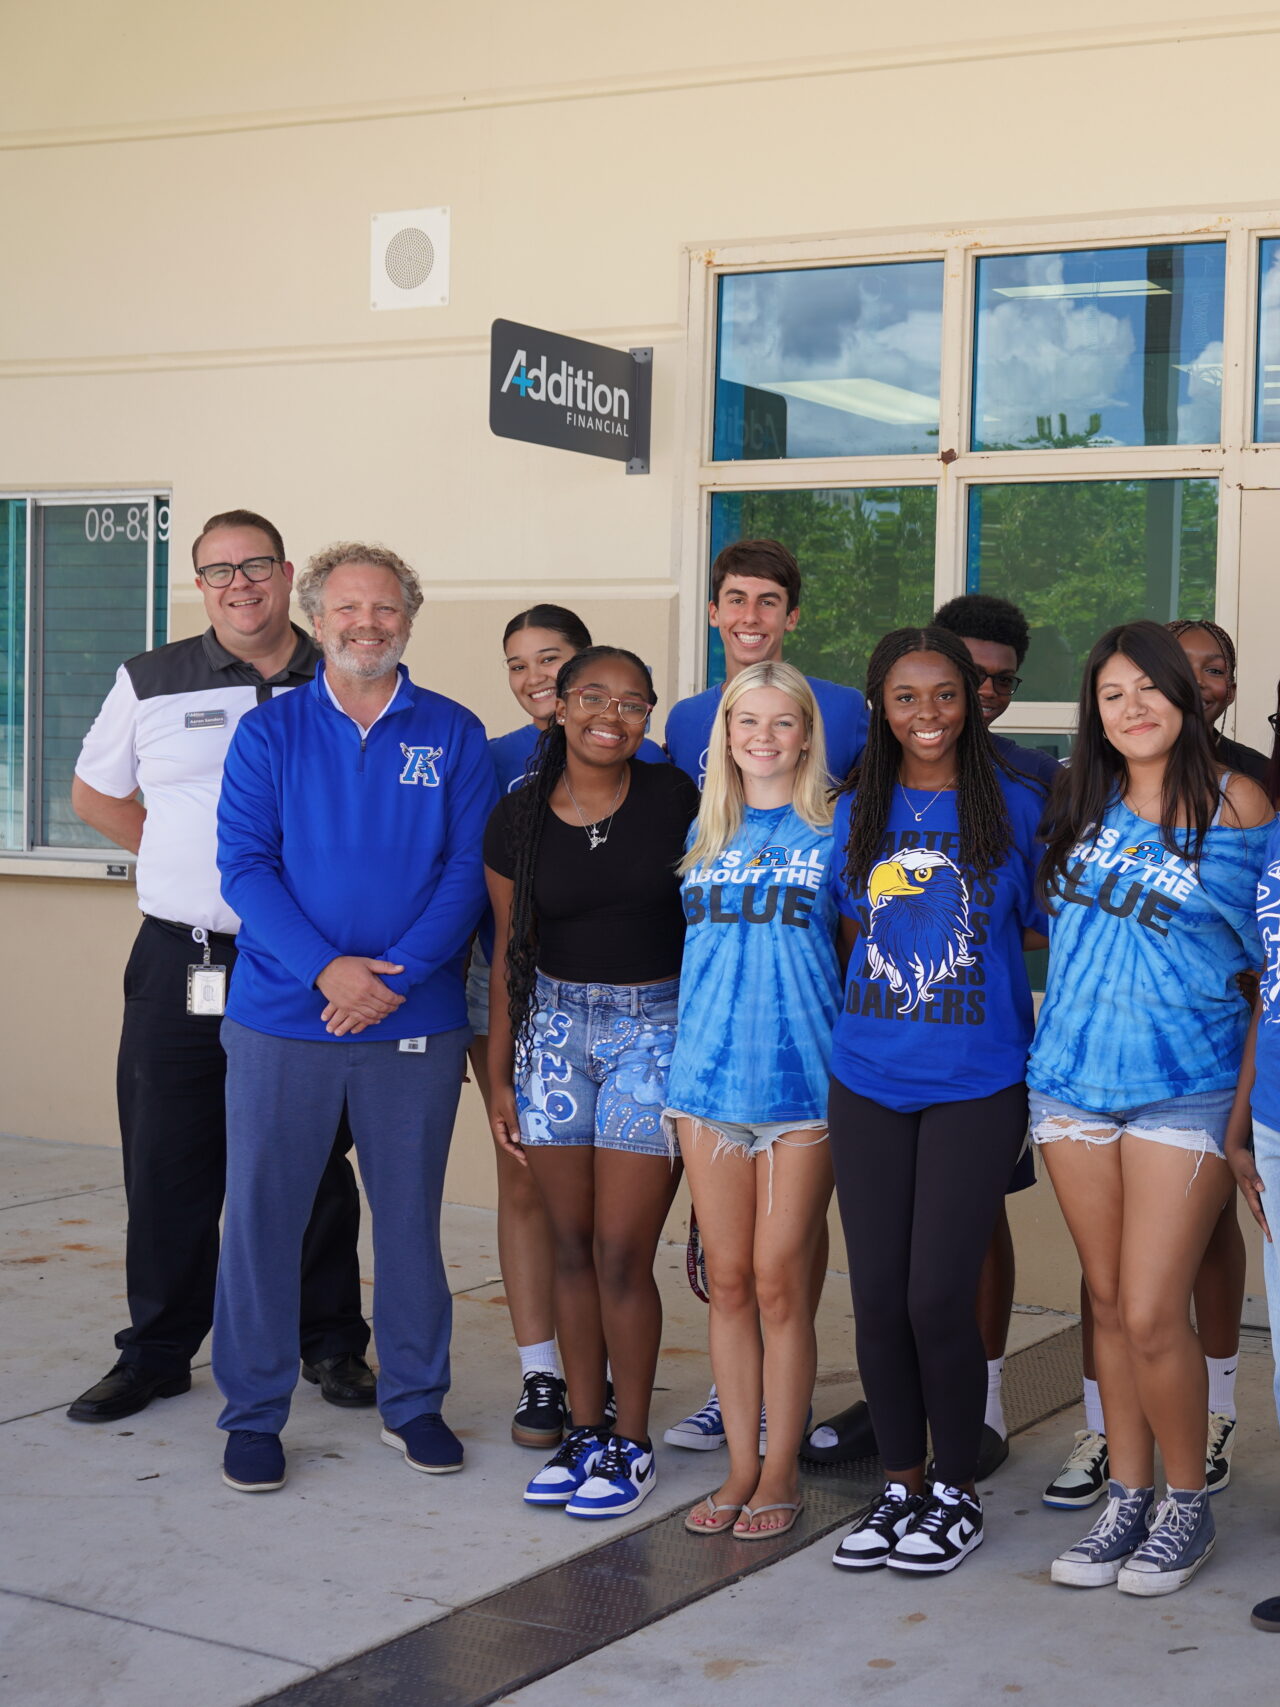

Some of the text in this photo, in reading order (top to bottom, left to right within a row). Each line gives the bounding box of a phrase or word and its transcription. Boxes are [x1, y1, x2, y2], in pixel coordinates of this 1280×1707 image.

[501, 349, 630, 420] Addition
[567, 412, 629, 437] FINANCIAL
[772, 868, 823, 890] THE
[1141, 865, 1195, 902] THE
[683, 884, 817, 929] BLUE
